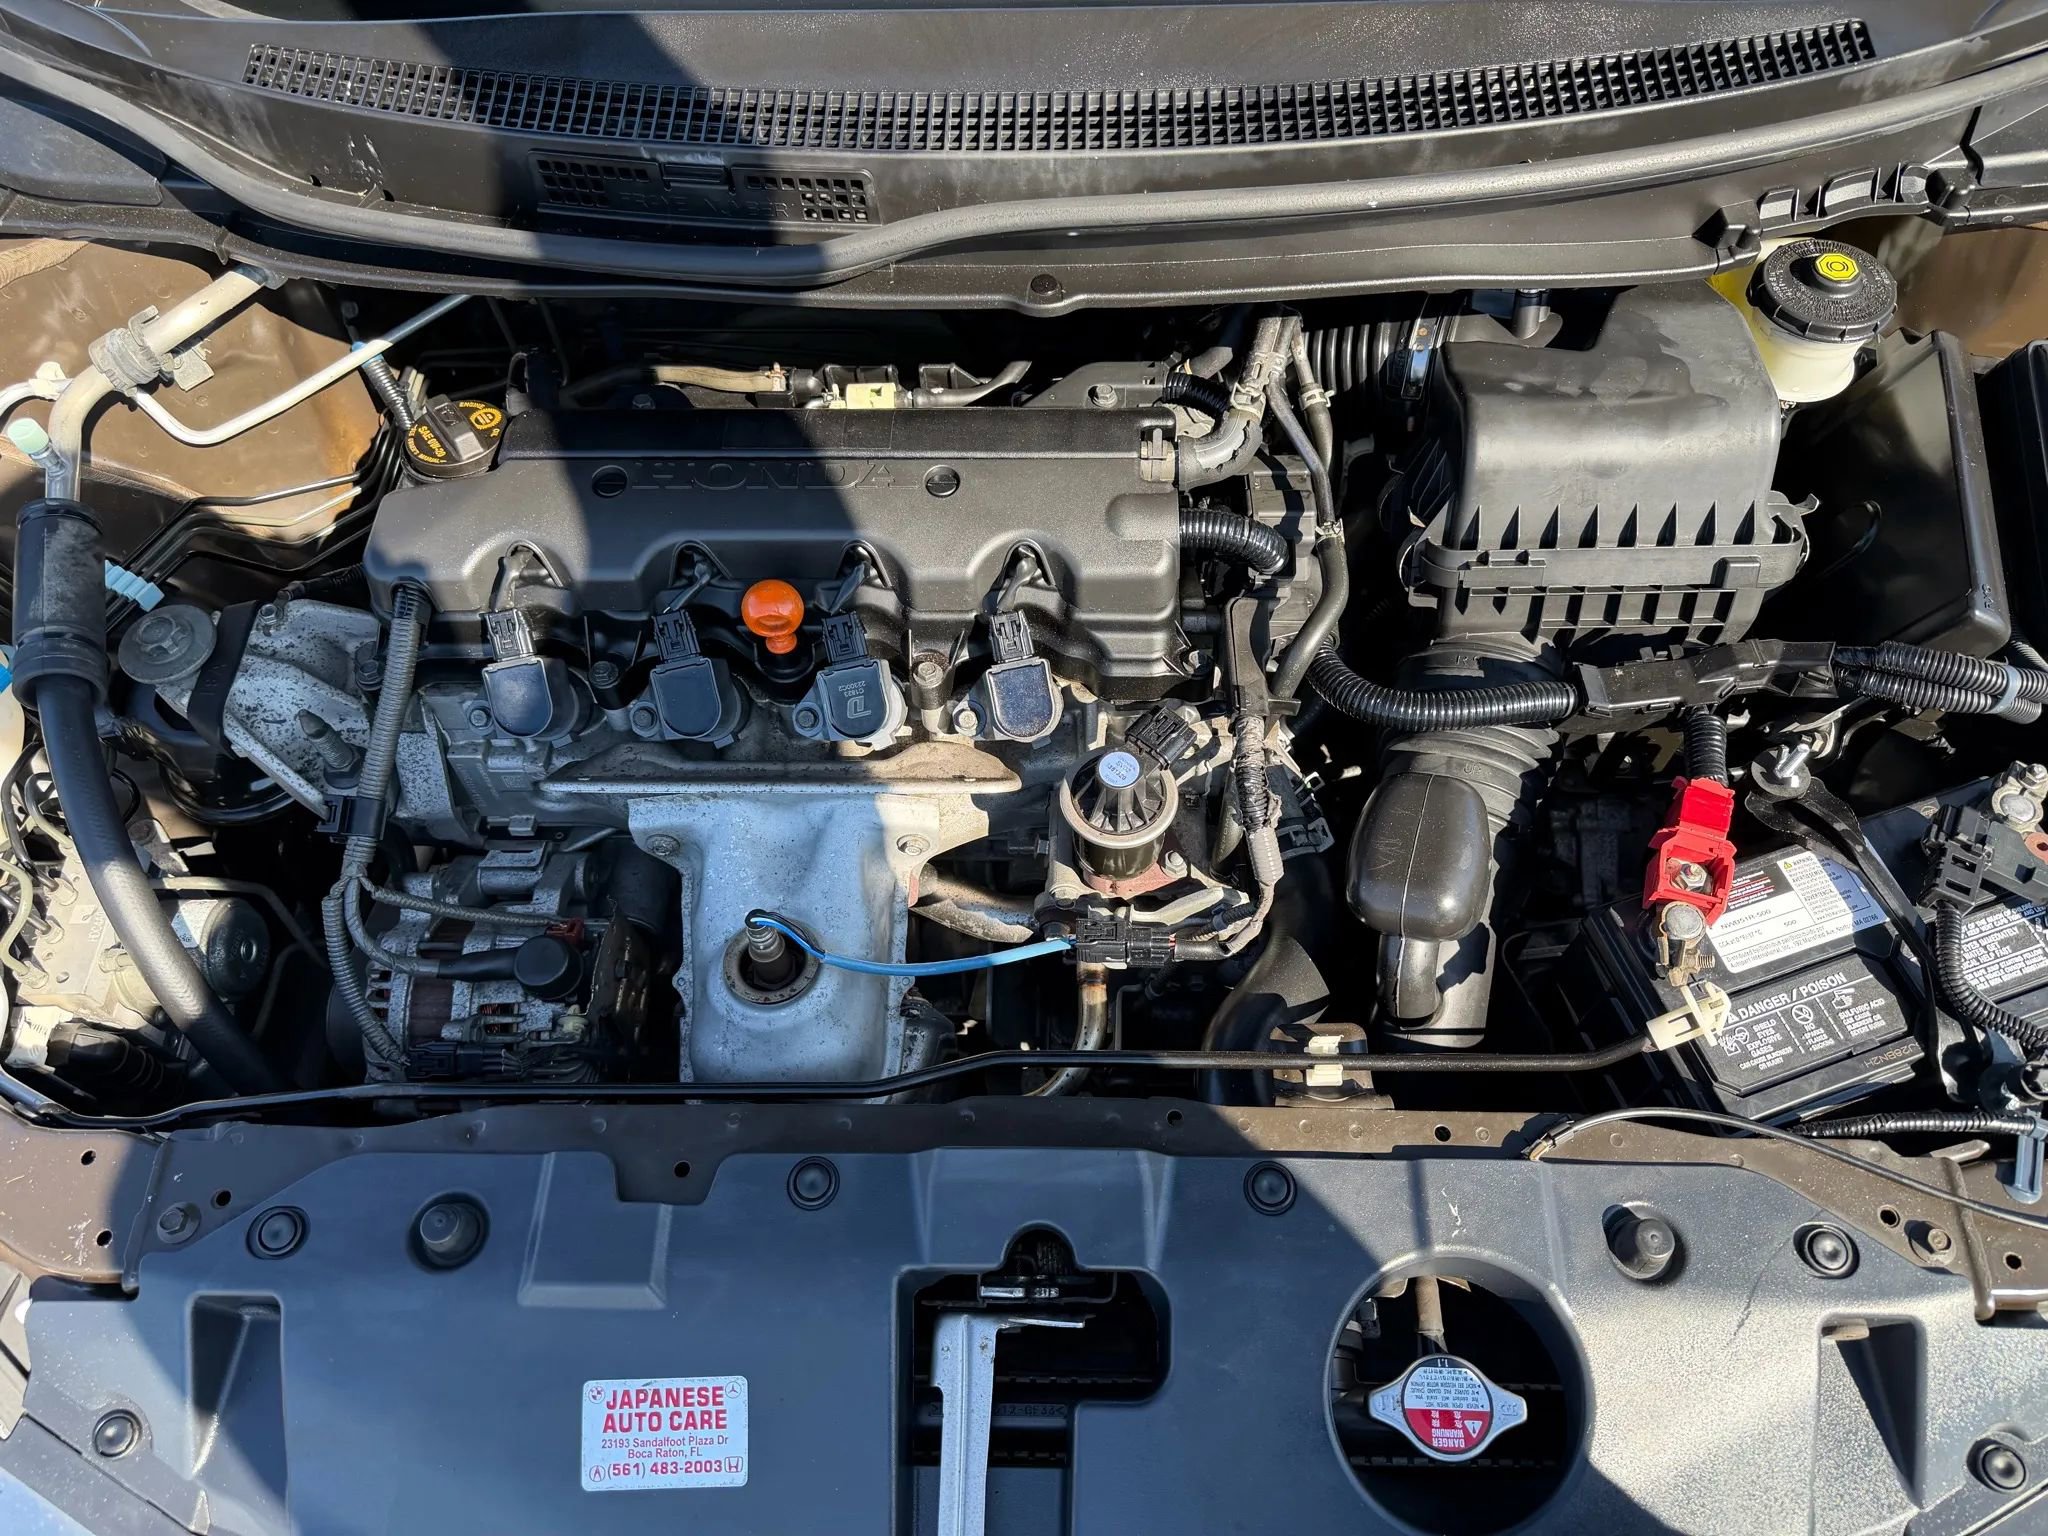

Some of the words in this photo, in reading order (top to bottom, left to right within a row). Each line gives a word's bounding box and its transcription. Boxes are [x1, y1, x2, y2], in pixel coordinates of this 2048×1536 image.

[418, 426, 434, 444] SAE
[631, 461, 919, 490] HONDA
[1792, 870, 1825, 883] AVERTISSEMEN
[1864, 914, 1879, 924] 02766
[1961, 940, 1980, 952] EYES
[1978, 926, 2019, 947] IMMEDIATELY
[1986, 942, 2001, 952] GET
[1978, 952, 1996, 964] HELP
[1994, 946, 2012, 958] FAST
[1737, 993, 1790, 1020] DANGER
[1799, 972, 1848, 998] POISON
[1838, 1003, 1871, 1020] SULFURIC
[1869, 998, 1886, 1010] ACID
[1752, 1018, 1777, 1033] SHIELD
[1803, 1022, 1816, 1032] NO
[1756, 1027, 1776, 1040] EYES
[1746, 1033, 1783, 1051] EXPLOSIVE
[1750, 1044, 1774, 1058] GASES
[1437, 1359, 1449, 1368] 1.1
[606, 1386, 725, 1410] JAPANESE
[602, 1411, 662, 1434] AUTO
[669, 1409, 728, 1431] CARE
[1431, 1428, 1465, 1438] WARNUNG
[601, 1438, 630, 1449] 23193
[633, 1436, 686, 1449] Sandalfoot
[688, 1435, 715, 1447] Plaza
[717, 1435, 729, 1445] Dr
[1432, 1438, 1465, 1448] DANGER
[628, 1449, 653, 1459] Boca
[655, 1447, 688, 1459] Raton,
[690, 1447, 703, 1457] FL
[607, 1462, 646, 1479] (561)
[650, 1460, 723, 1475] 483-2003
